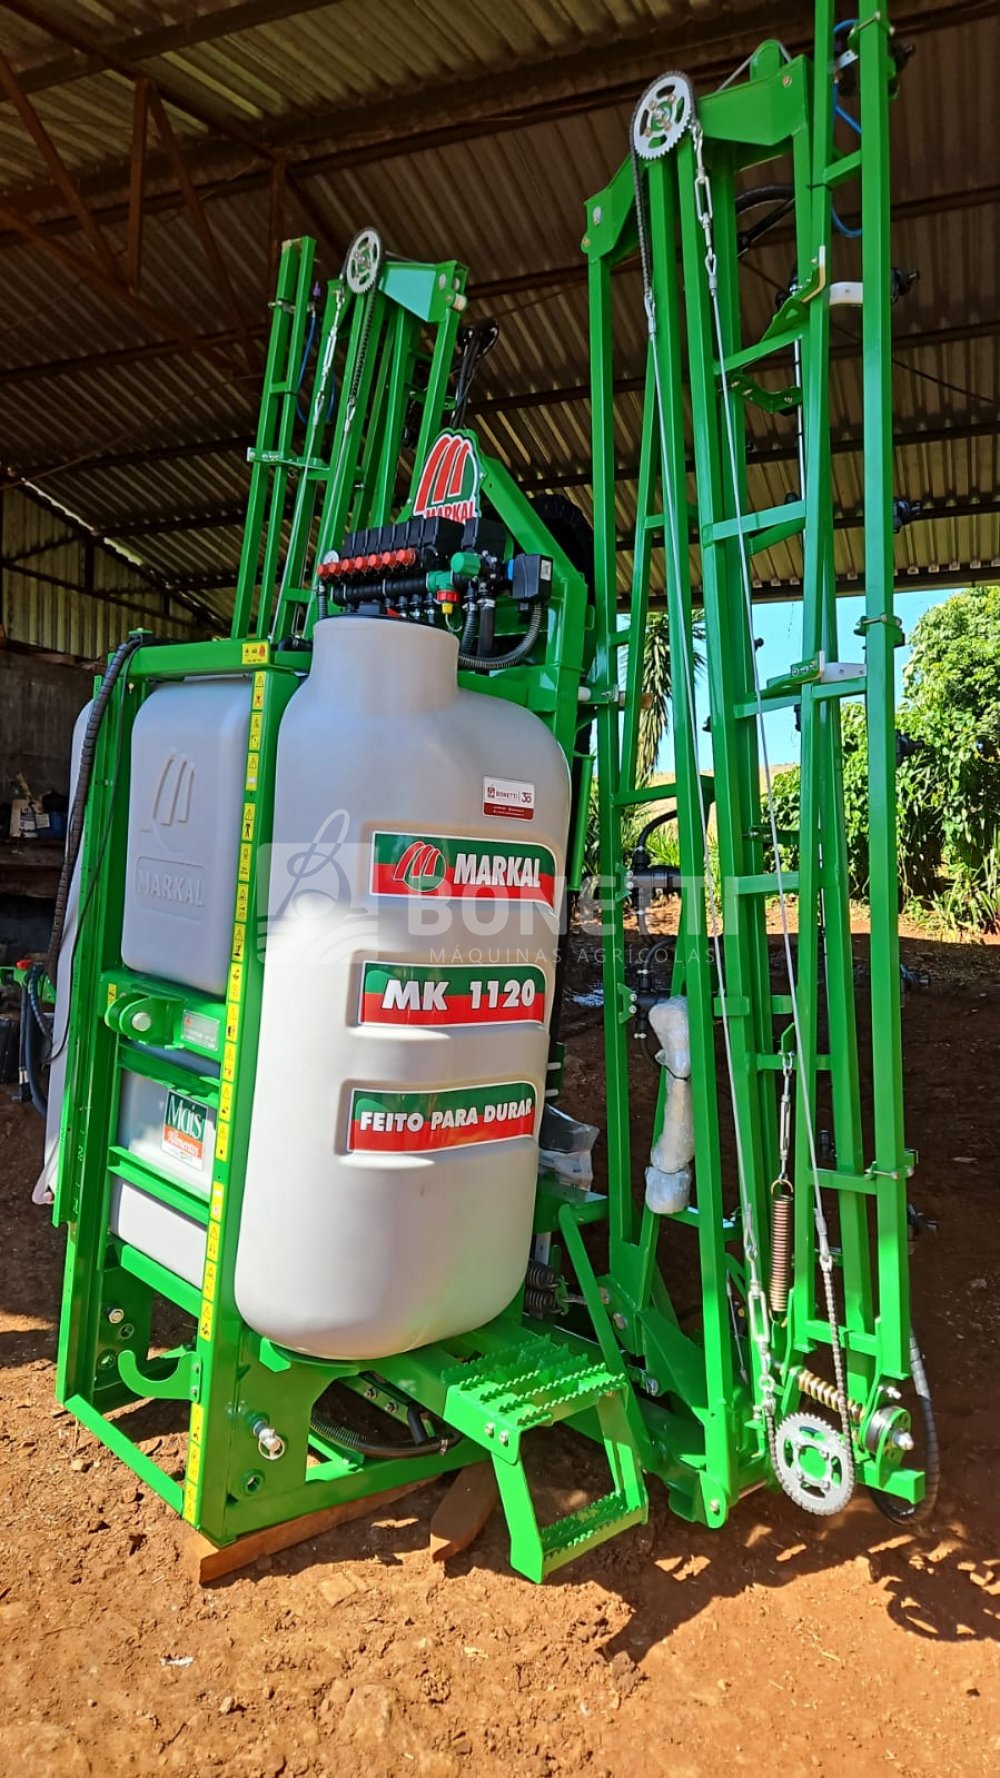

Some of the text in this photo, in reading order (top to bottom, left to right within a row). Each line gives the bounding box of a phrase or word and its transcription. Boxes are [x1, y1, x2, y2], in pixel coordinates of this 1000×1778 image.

[453, 853, 541, 888] MARKAL
[381, 978, 536, 1011] MK 1120
[167, 1095, 202, 1139] Mais
[359, 1098, 533, 1133] FEITO PARA DURAR
